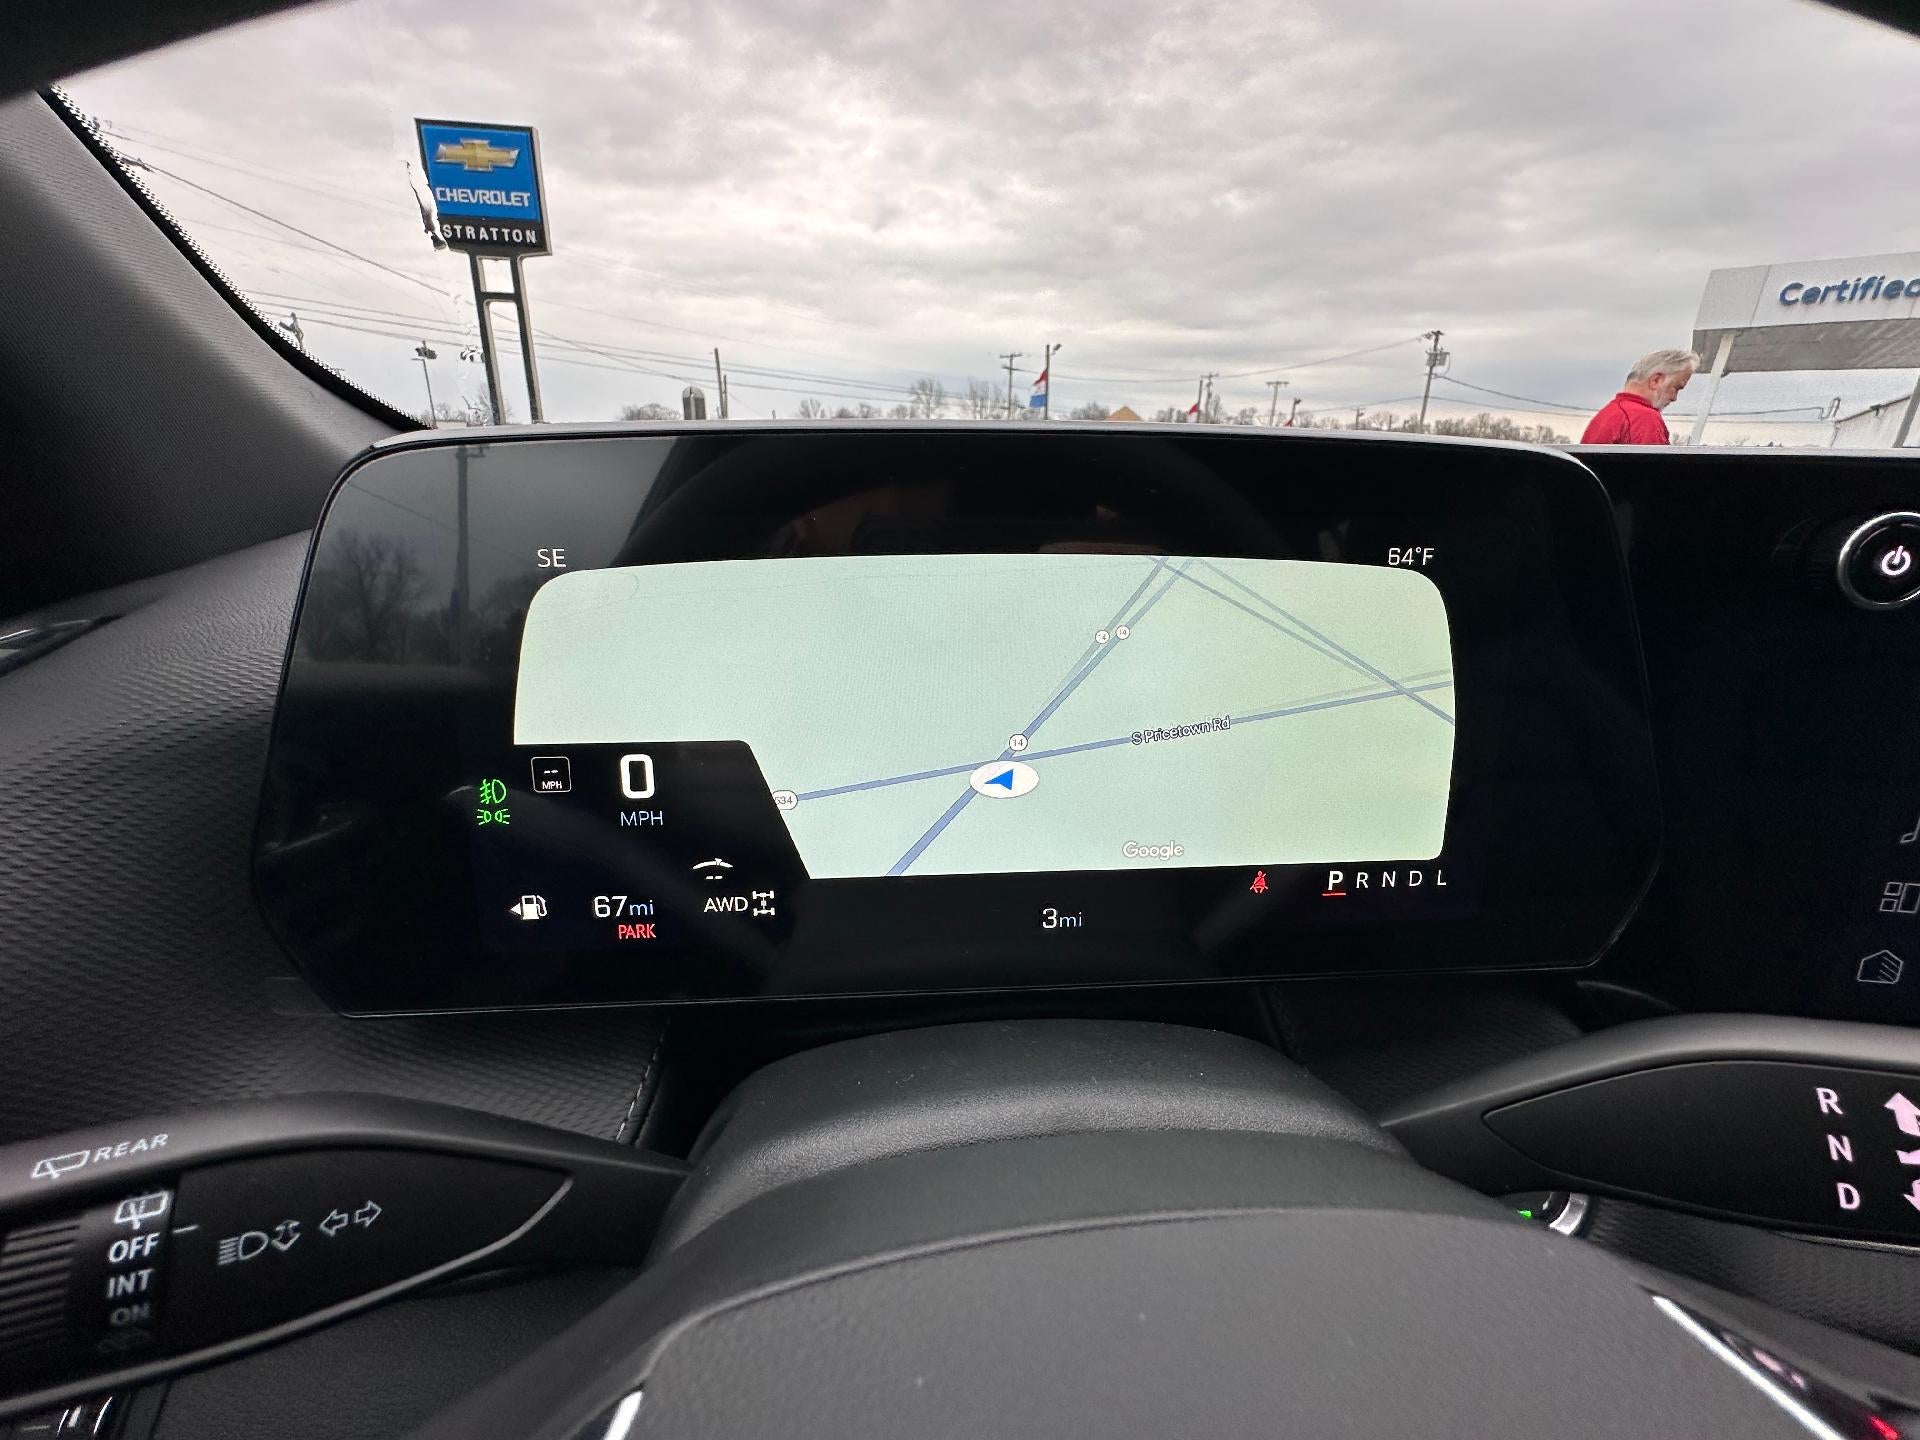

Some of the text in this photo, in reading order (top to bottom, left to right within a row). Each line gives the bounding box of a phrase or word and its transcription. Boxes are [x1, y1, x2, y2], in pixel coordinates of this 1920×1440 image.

[435, 187, 530, 207] CHEVROLET
[442, 224, 537, 243] STRATTON
[537, 548, 567, 568] SE
[1387, 547, 1435, 566] 64°F
[1132, 715, 1231, 745] S Pricetown Rd
[541, 780, 563, 790] MPH
[619, 753, 656, 800] 0
[620, 810, 664, 827] MPH
[1123, 840, 1184, 861] Google
[1328, 869, 1447, 891] P R N D L
[703, 896, 749, 913] AWD
[617, 923, 657, 940] PARK
[1816, 1087, 1844, 1115] R
[93, 1133, 169, 1163] REAR
[1827, 1134, 1853, 1162] N
[1836, 1182, 1861, 1210] D
[108, 1233, 161, 1264] OFF
[107, 1268, 154, 1298] INT
[110, 1303, 151, 1326] ON
